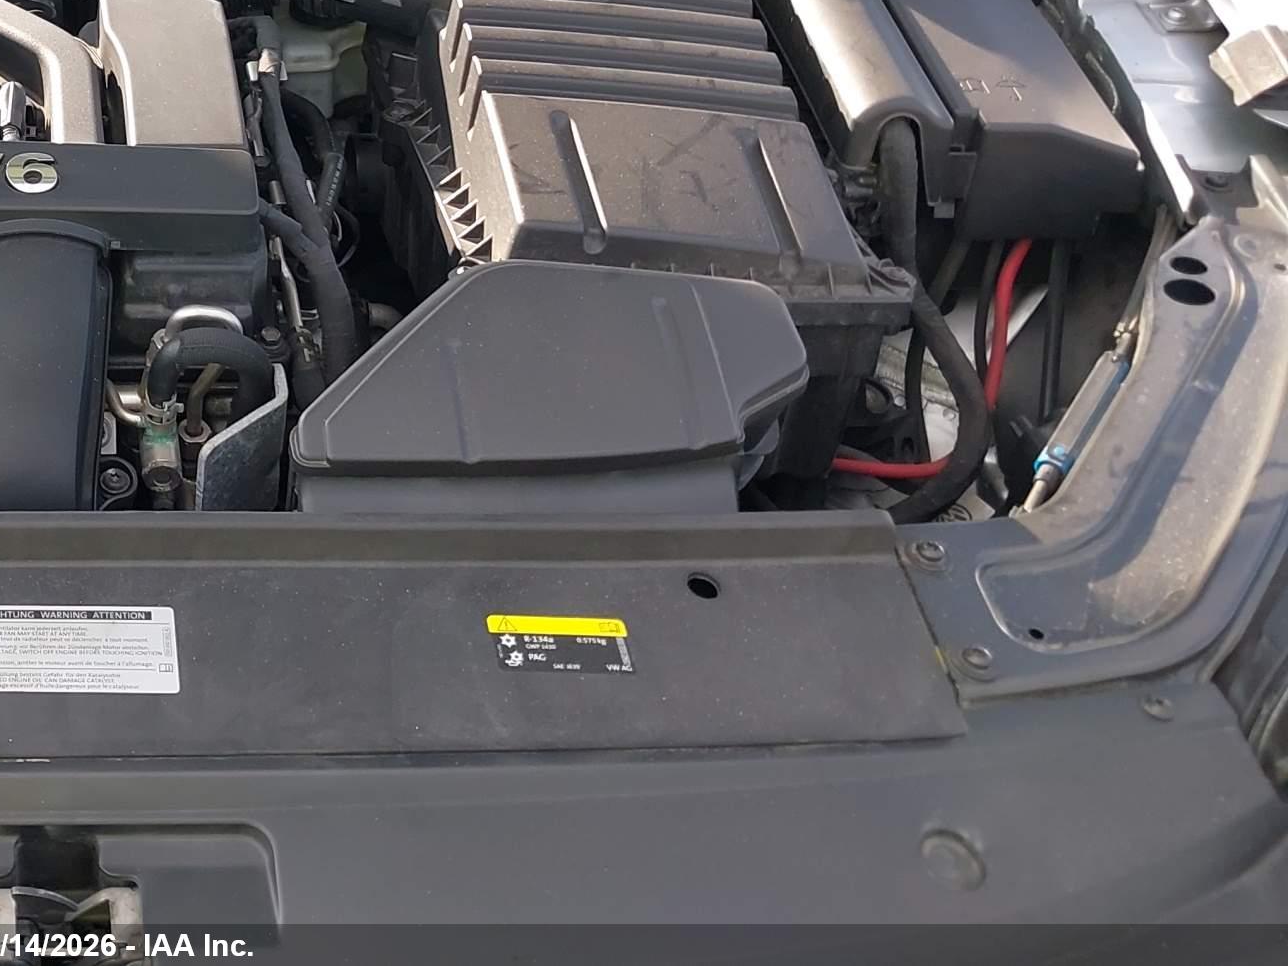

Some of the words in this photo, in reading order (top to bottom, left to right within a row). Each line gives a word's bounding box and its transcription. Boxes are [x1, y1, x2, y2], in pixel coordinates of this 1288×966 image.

[40, 611, 88, 619] WARNING
[92, 612, 146, 620] ATTENTION
[528, 653, 547, 661] PAG
